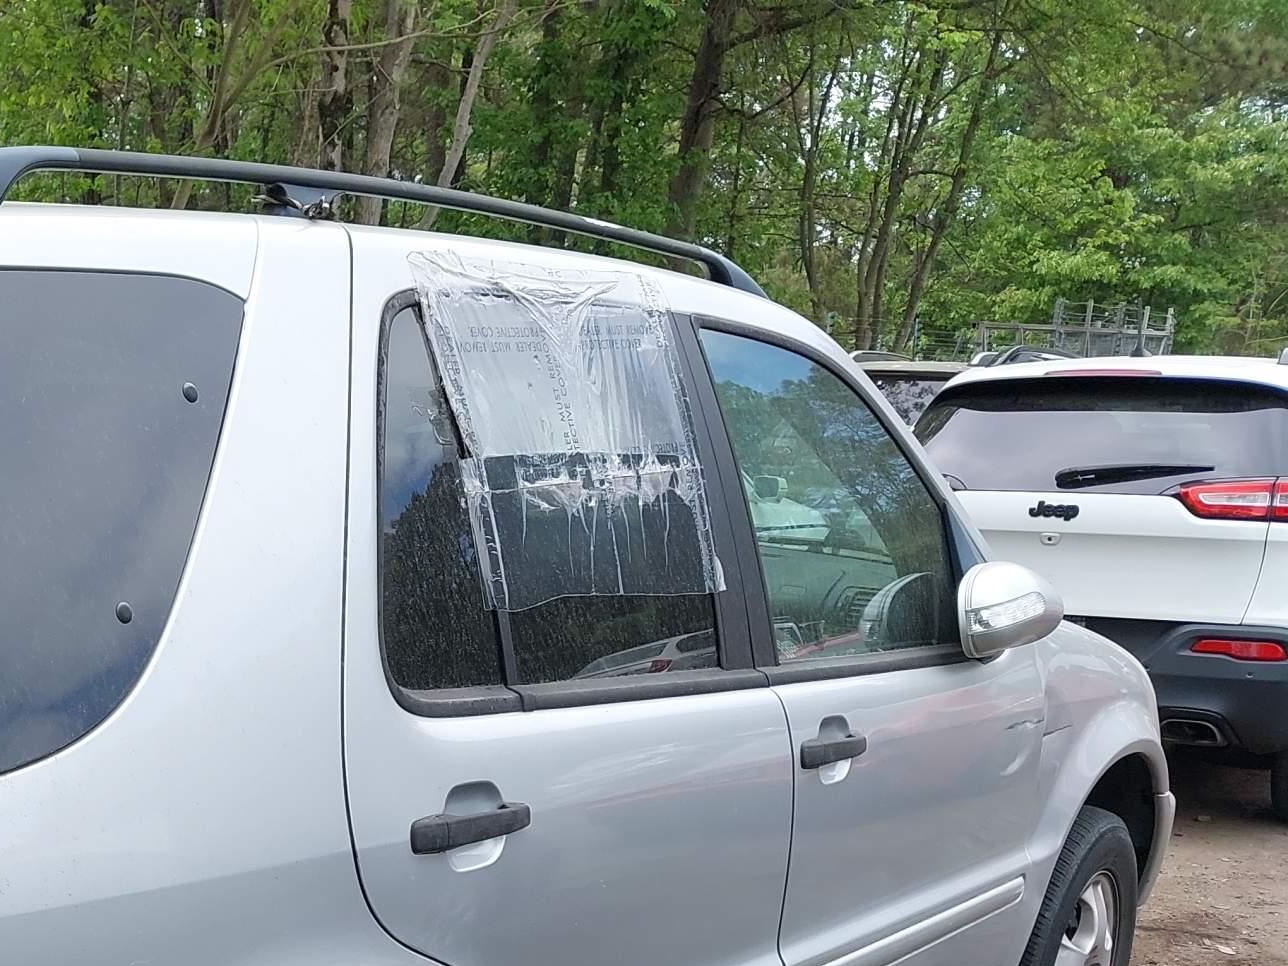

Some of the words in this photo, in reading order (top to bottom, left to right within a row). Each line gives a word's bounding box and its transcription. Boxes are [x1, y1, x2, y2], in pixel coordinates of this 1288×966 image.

[552, 388, 566, 422] MUST
[564, 401, 582, 451] TECTIVE
[1029, 500, 1079, 521] Jeep
